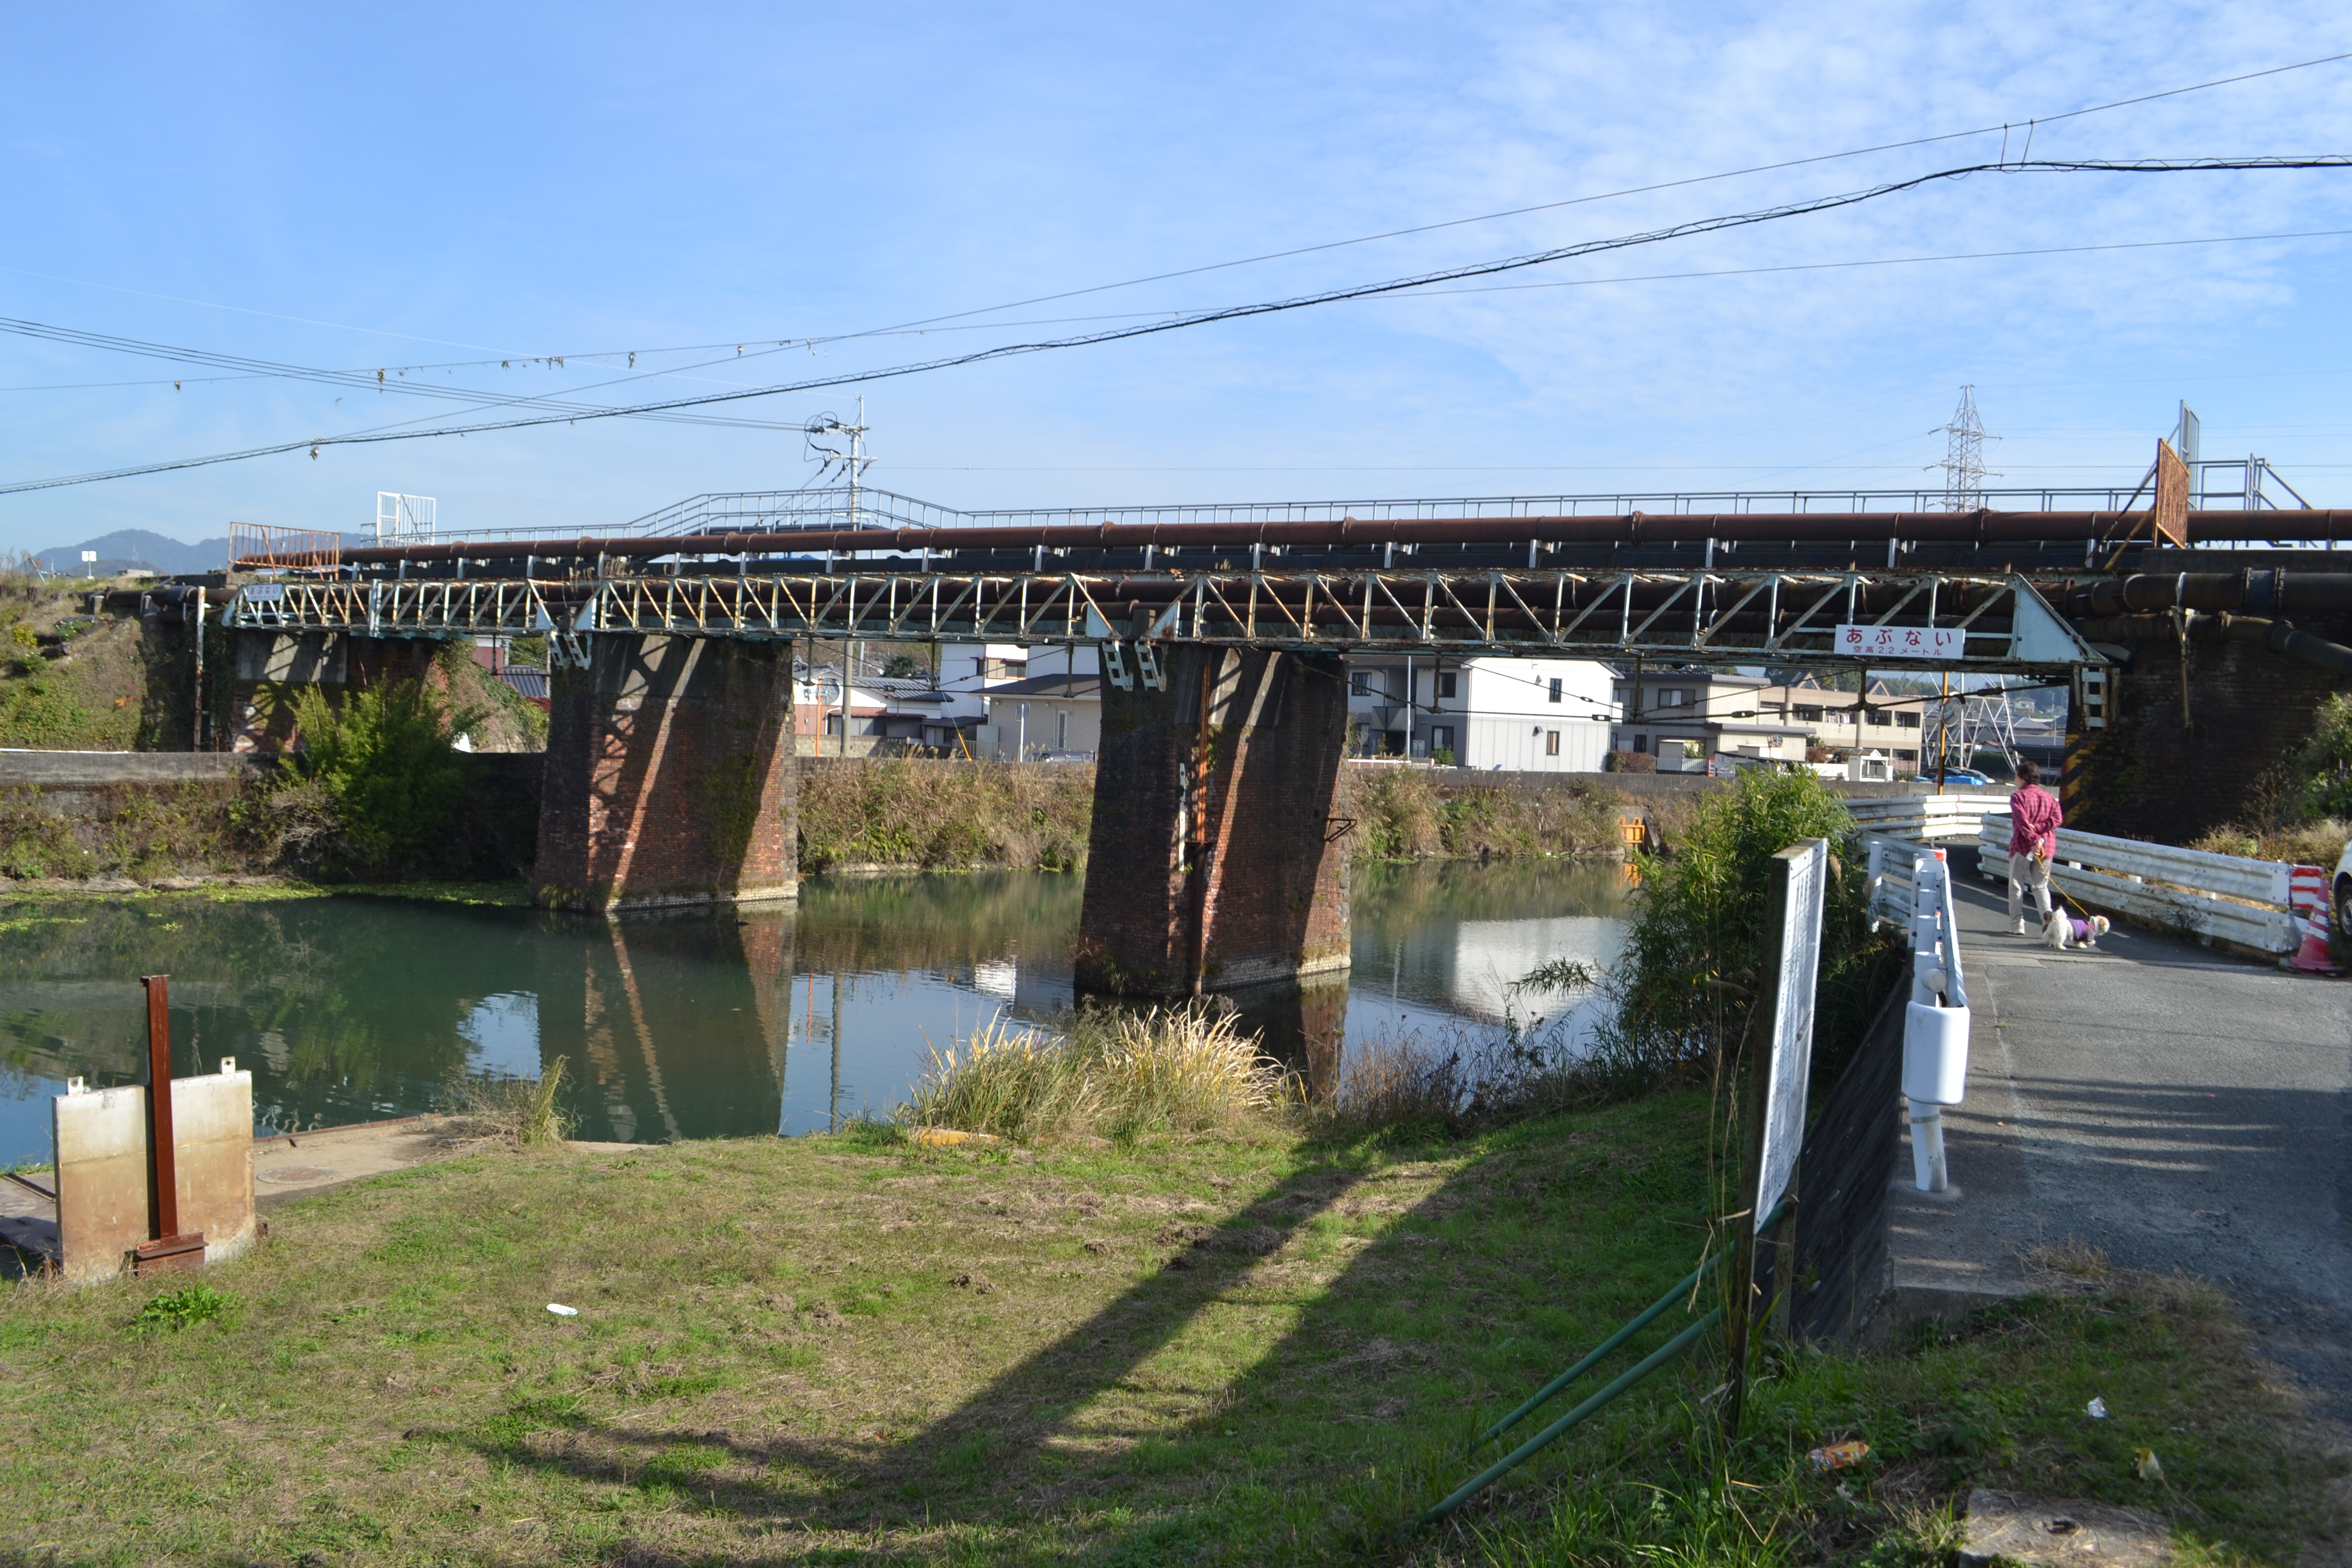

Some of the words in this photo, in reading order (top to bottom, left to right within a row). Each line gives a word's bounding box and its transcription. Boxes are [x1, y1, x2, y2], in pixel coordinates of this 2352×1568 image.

[1846, 628, 1951, 646] あぶない
[1853, 646, 1942, 656] 空高2.2メートル
